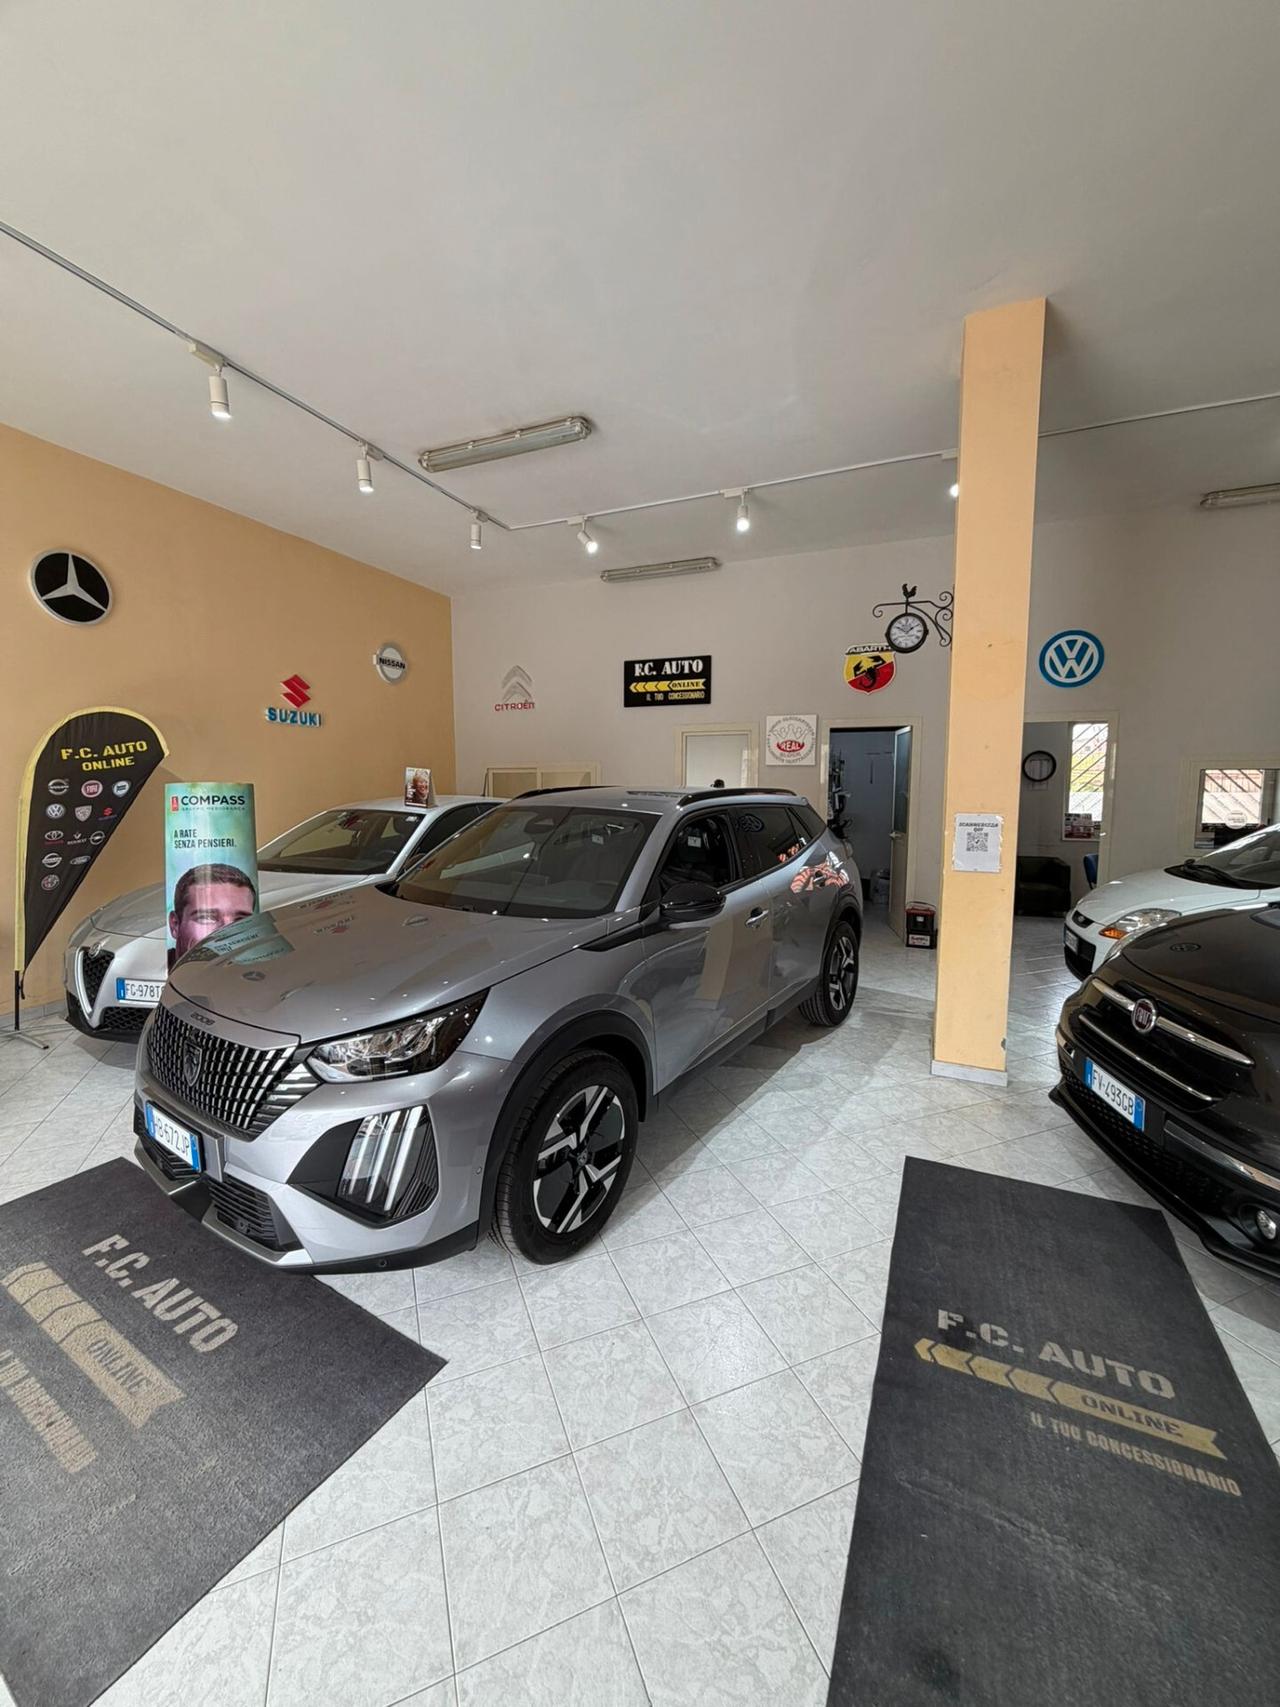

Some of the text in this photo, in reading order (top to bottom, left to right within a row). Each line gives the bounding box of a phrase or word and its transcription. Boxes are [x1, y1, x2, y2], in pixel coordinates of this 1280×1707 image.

[379, 657, 405, 670] NISSAN
[661, 658, 704, 675] AUTO
[672, 680, 701, 688] ONLINE
[267, 706, 322, 727] SUZUKI
[60, 740, 148, 761] F.C. AUTO
[82, 756, 135, 772] ONLINE
[181, 795, 246, 806] COMPASS
[174, 829, 197, 838] A RATE
[174, 838, 237, 849] SENZA PENSIERI.
[82, 1233, 239, 1353] F.C. AUTO
[937, 1308, 1176, 1400] F.C. AUTO
[1080, 1394, 1184, 1438] ONLINE
[1050, 1416, 1082, 1441] TUO
[1086, 1429, 1242, 1497] CONCESSIONARIO
